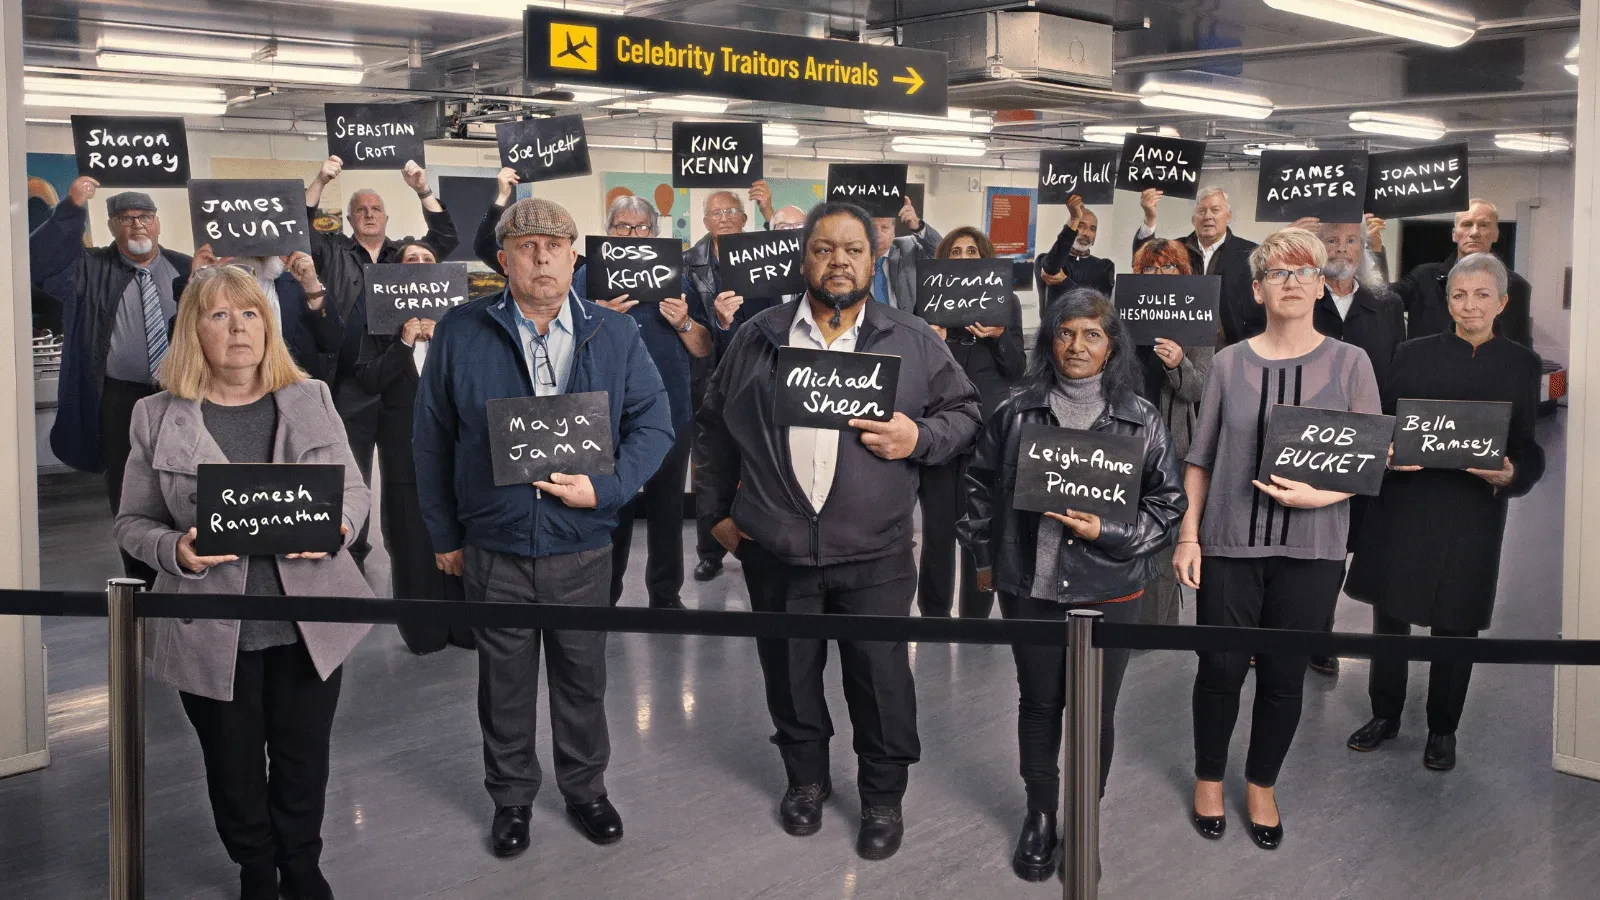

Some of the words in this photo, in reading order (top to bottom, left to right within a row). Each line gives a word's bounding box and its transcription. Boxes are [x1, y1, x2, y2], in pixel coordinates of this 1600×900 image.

[617, 35, 715, 76] Celebrity
[720, 46, 800, 79] Traitors
[804, 55, 879, 87] Arrivals
[334, 115, 415, 139] SEBASTIAN
[85, 128, 170, 148] Sharon
[691, 135, 738, 154] KING
[354, 141, 396, 161] CROFT
[507, 143, 534, 163] Joe
[1132, 144, 1189, 165] AMOL
[88, 152, 179, 173] Rooney
[681, 153, 754, 176] KENNY
[1280, 164, 1345, 182] JAMES
[1380, 158, 1459, 181] JOANNE
[1042, 163, 1078, 193] Jerry
[1083, 161, 1112, 184] Hall
[1128, 165, 1197, 183] RAJAN
[1266, 180, 1356, 202] ACASTER
[201, 197, 284, 214] James
[601, 241, 658, 262] ROSS
[729, 237, 801, 266] HANNAH
[607, 265, 672, 290] KEMP
[749, 259, 792, 284] FRY
[923, 271, 1004, 288] Miranda
[373, 280, 450, 295] RICHARDY
[394, 295, 465, 310] GRANT
[923, 291, 992, 312] Heart
[1137, 293, 1177, 306] JULIE
[1120, 307, 1213, 322] HESMONDHALGH
[786, 362, 883, 391] Michael
[802, 390, 885, 417] Sheen
[509, 415, 590, 437] Maya
[1401, 414, 1456, 432] Bella
[1300, 424, 1357, 446] ROB
[509, 439, 602, 461] Jama
[1028, 442, 1134, 475] Leigh-Anne
[1274, 446, 1376, 474] BUCKET
[221, 484, 313, 505] Romesh
[1045, 471, 1127, 505] Pinnock
[210, 509, 330, 536] Ranganathan
